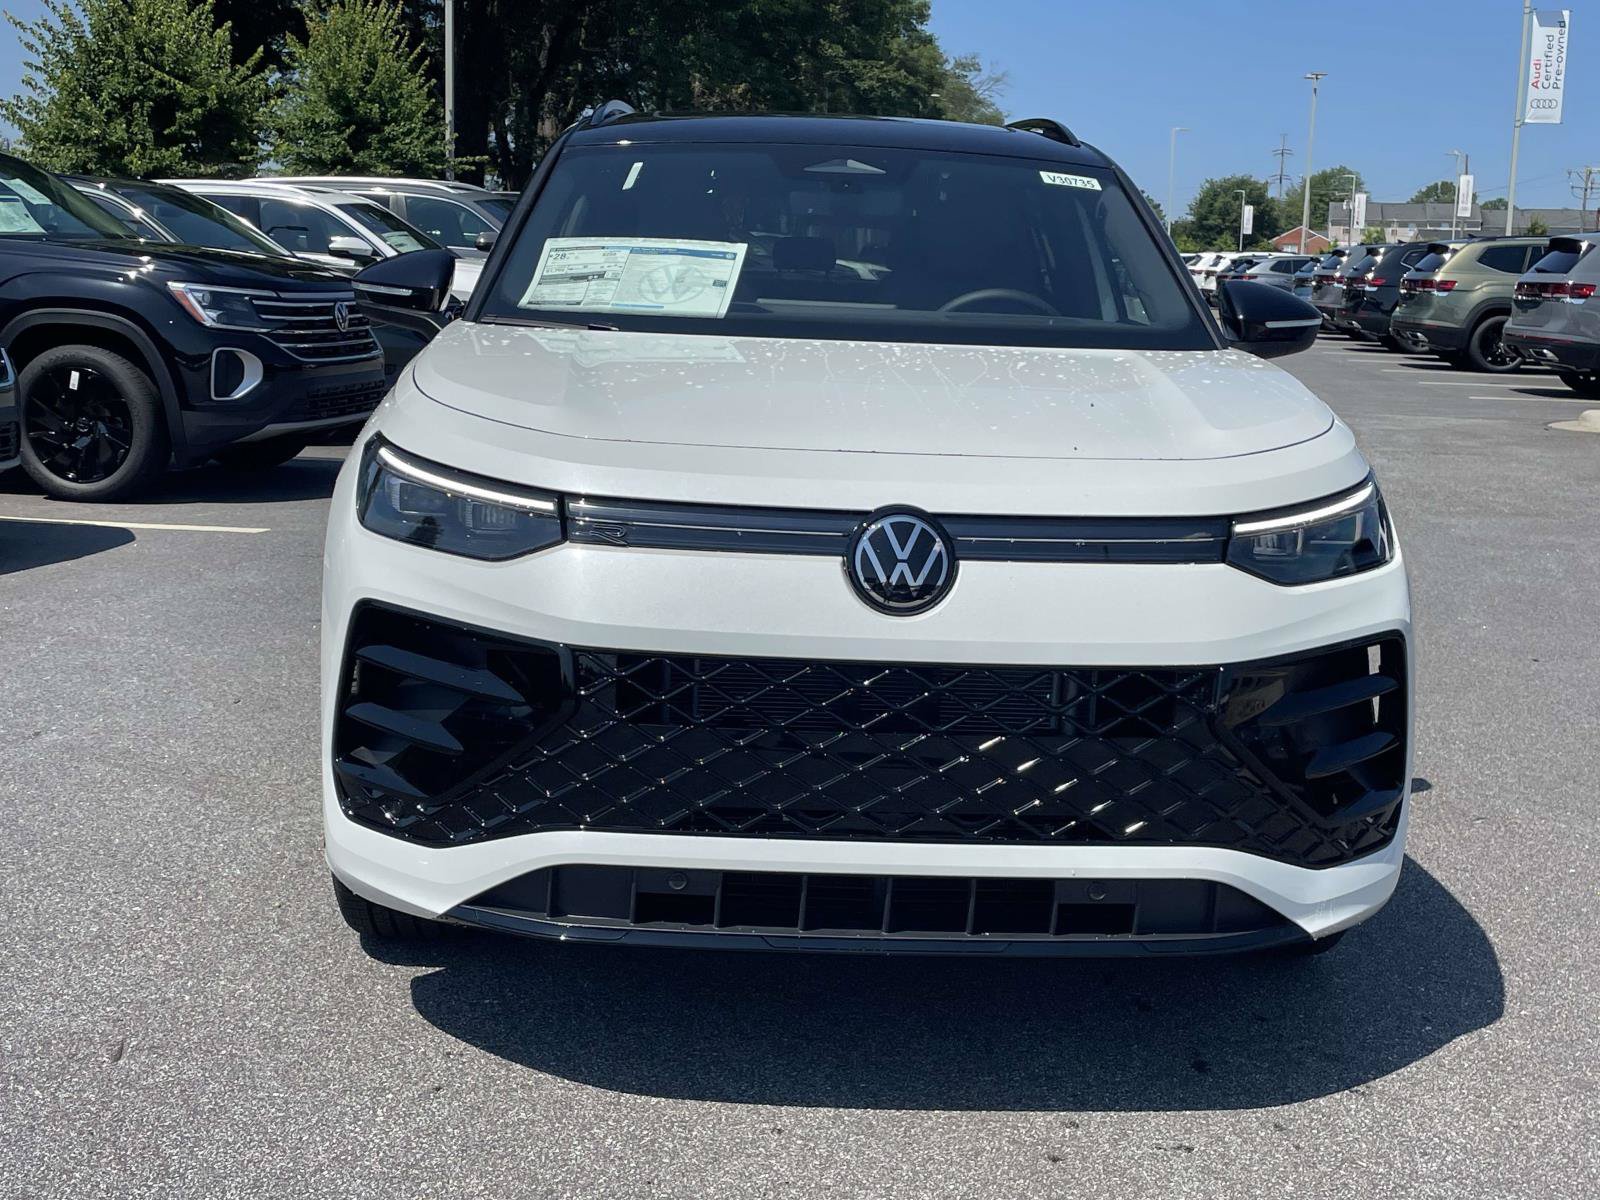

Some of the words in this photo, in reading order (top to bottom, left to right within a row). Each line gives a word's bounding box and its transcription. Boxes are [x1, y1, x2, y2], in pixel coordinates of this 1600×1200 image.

[1531, 59, 1541, 89] Audi
[1542, 34, 1554, 89] Certified
[1552, 20, 1566, 89] Pre-owned
[1046, 174, 1095, 189] V30735
